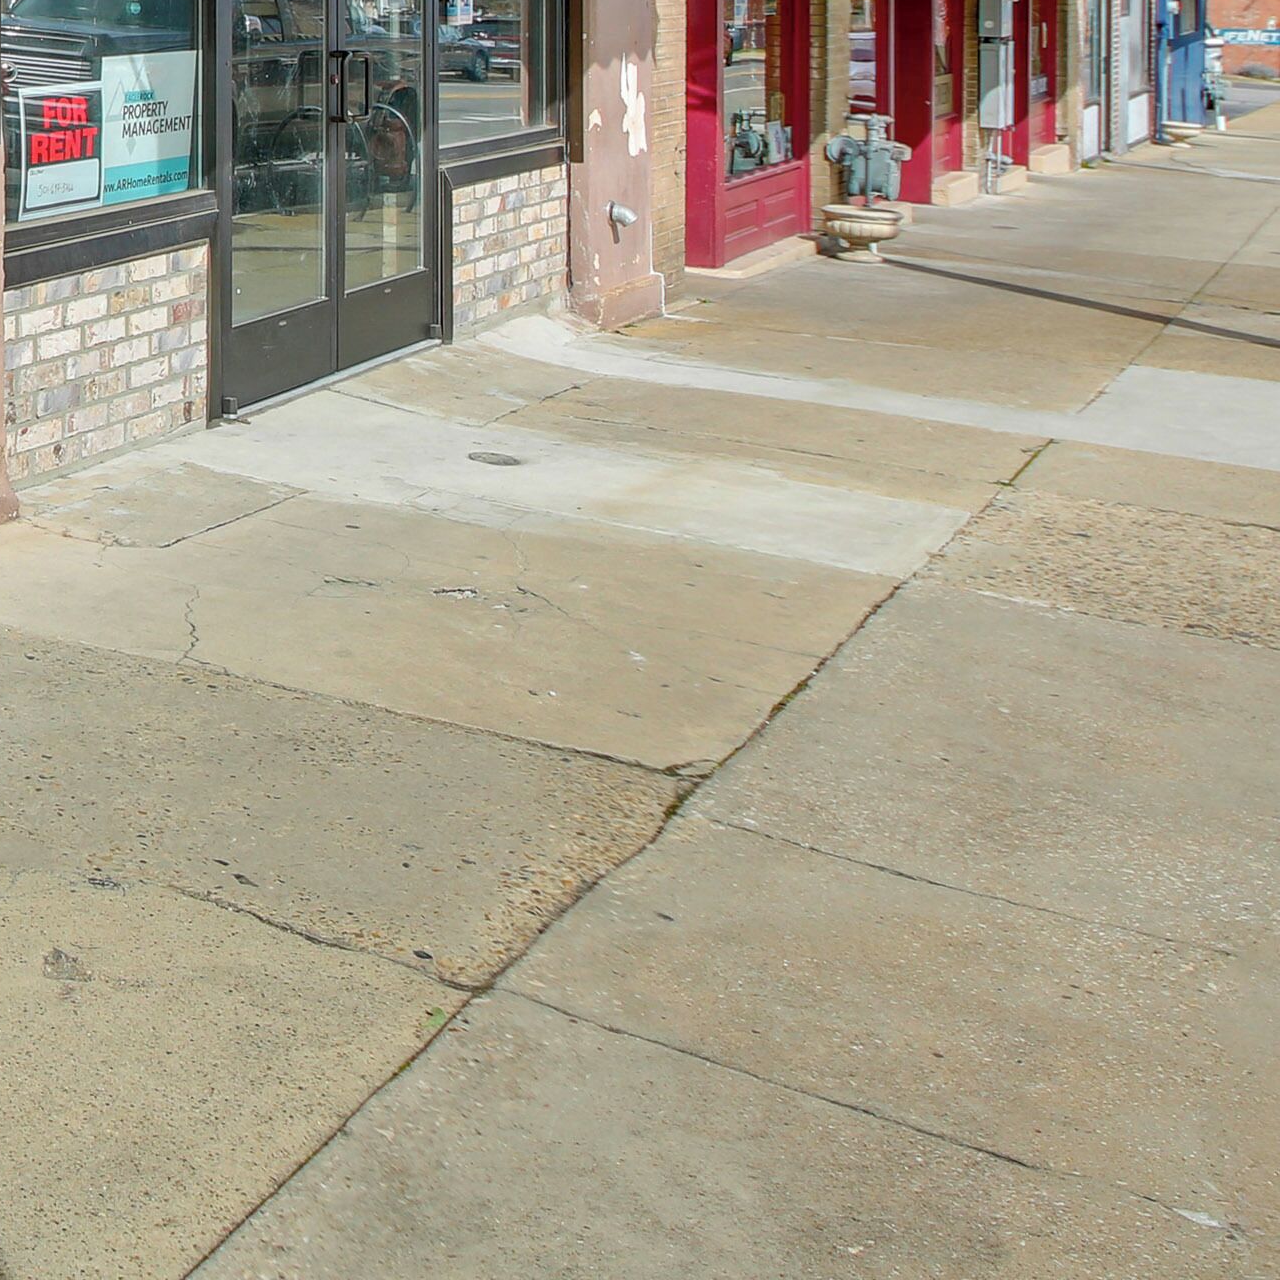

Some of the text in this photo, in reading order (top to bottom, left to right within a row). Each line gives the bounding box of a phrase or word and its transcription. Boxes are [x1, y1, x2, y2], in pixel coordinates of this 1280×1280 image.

[43, 96, 89, 129] FOR
[122, 100, 169, 120] PROPERTY
[121, 115, 191, 138] MANAGEMENT
[31, 127, 99, 165] RENT
